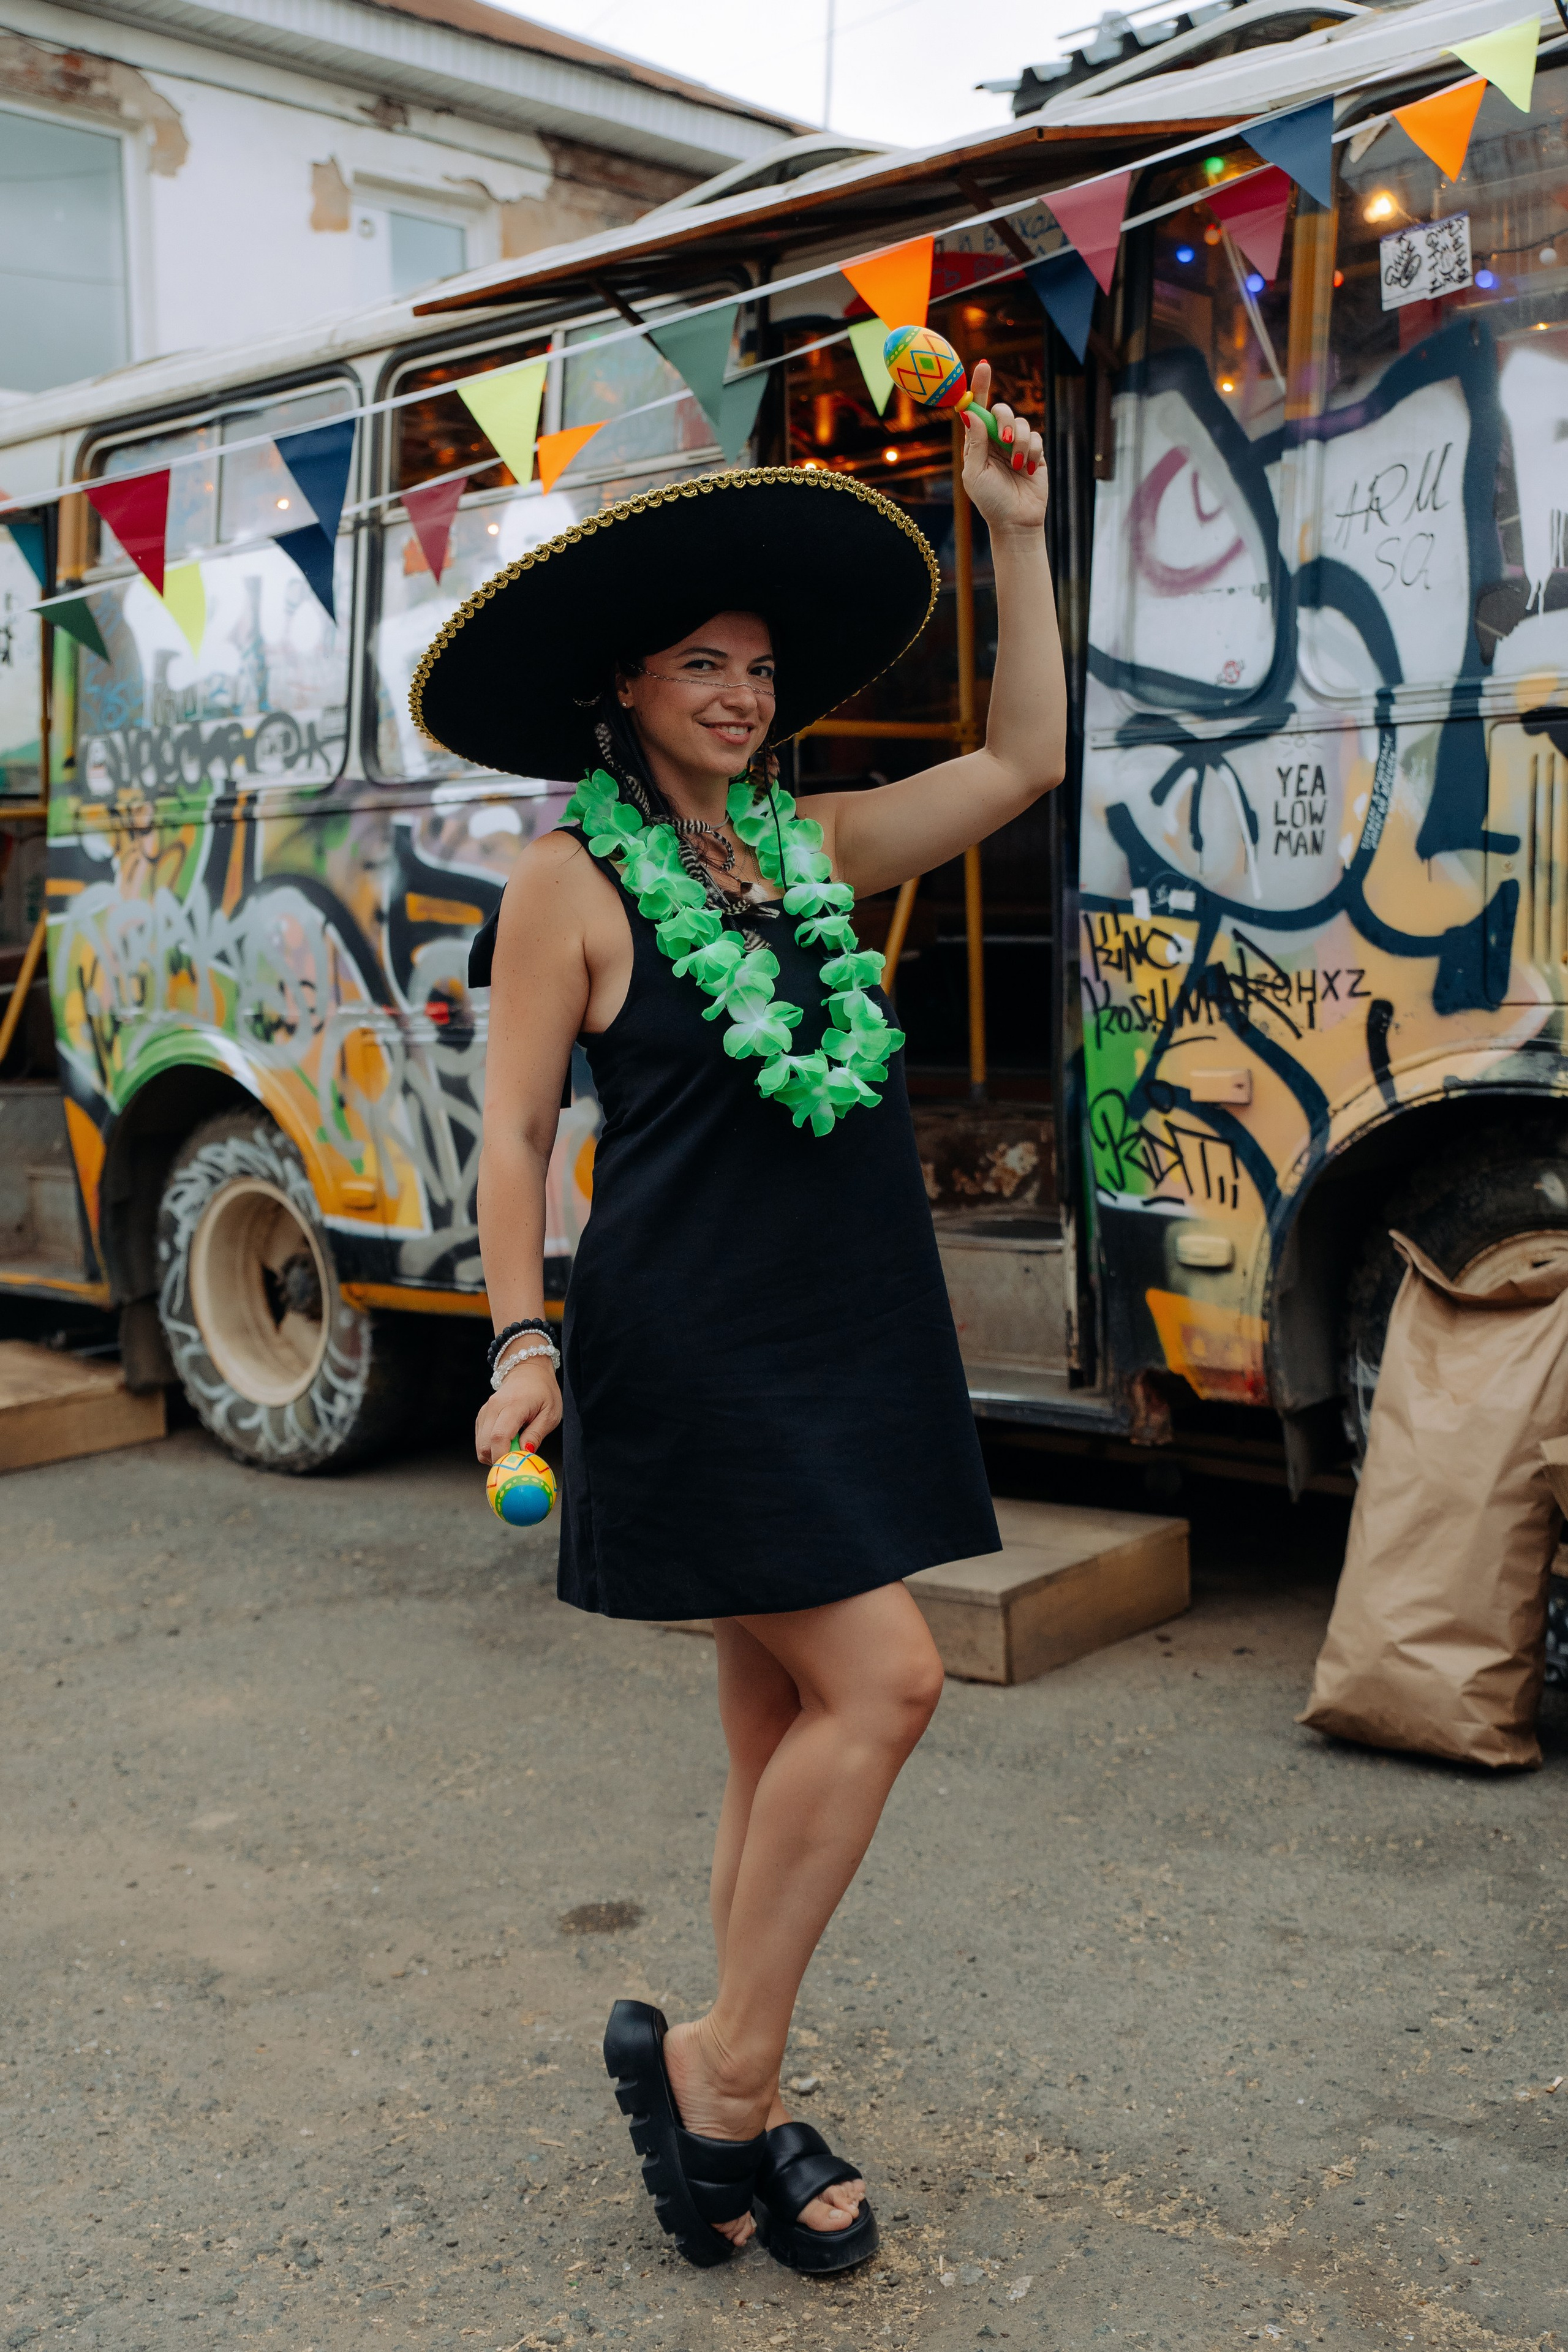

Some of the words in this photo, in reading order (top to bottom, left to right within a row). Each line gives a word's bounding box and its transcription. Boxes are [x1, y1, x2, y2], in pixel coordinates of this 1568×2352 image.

[1276, 764, 1327, 797] YEA
[1273, 799, 1329, 827] LOW
[1274, 829, 1326, 857] MAN
